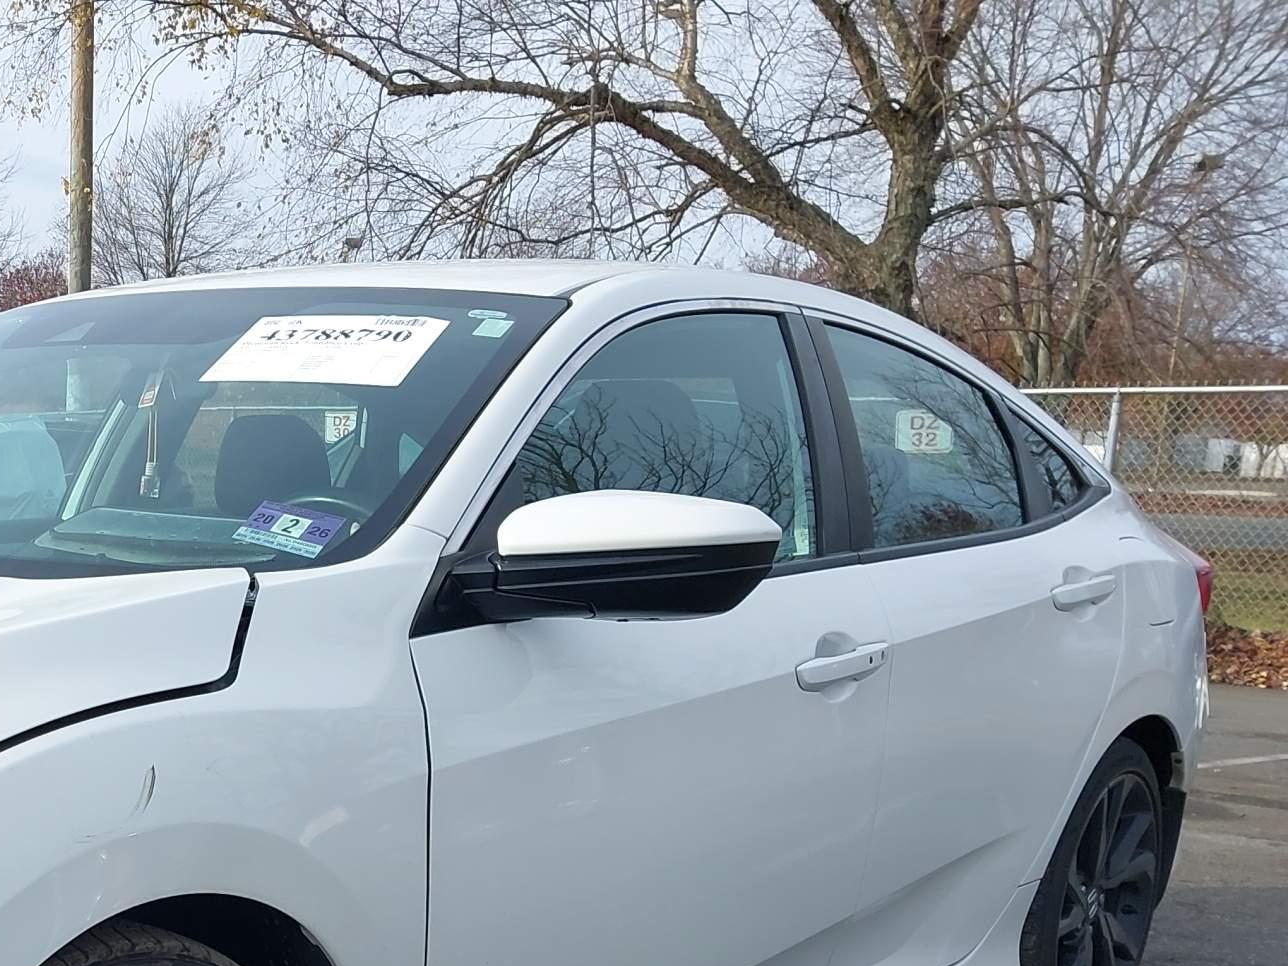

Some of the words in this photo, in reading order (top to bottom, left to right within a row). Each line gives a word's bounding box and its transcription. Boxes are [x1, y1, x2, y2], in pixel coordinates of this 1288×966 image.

[333, 415, 351, 427] DZ
[910, 415, 939, 430] DZ
[911, 432, 938, 447] 32
[253, 512, 275, 525] 20
[281, 518, 300, 533] 2
[306, 525, 331, 538] 26
